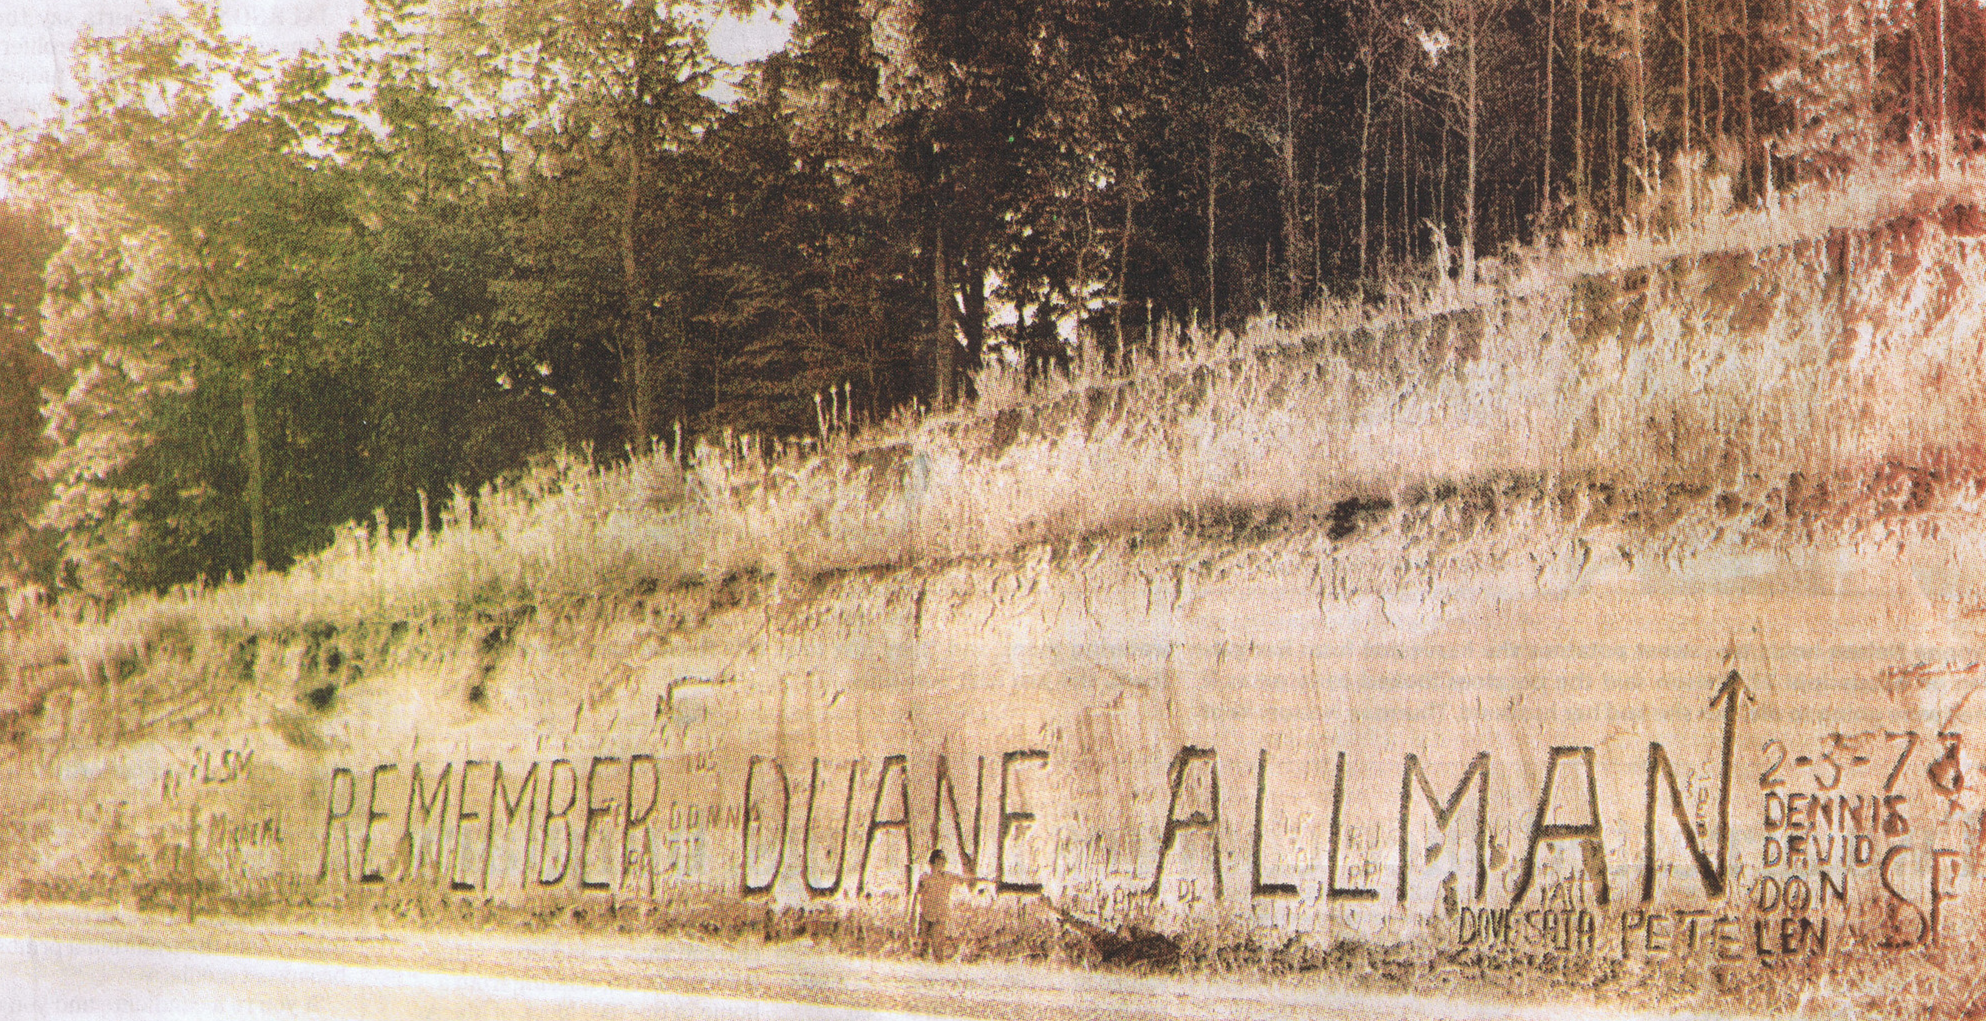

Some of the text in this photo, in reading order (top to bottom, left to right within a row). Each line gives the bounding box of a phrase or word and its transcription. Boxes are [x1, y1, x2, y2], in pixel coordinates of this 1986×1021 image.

[318, 754, 660, 896] REMEMBER
[740, 749, 1050, 898] DUANE
[1146, 742, 1739, 906] ALLMAN
[1764, 791, 1910, 838] DENNIS
[1758, 871, 1848, 913] DON
[1621, 909, 1744, 961] PETE
[1754, 917, 1829, 956] LEN
